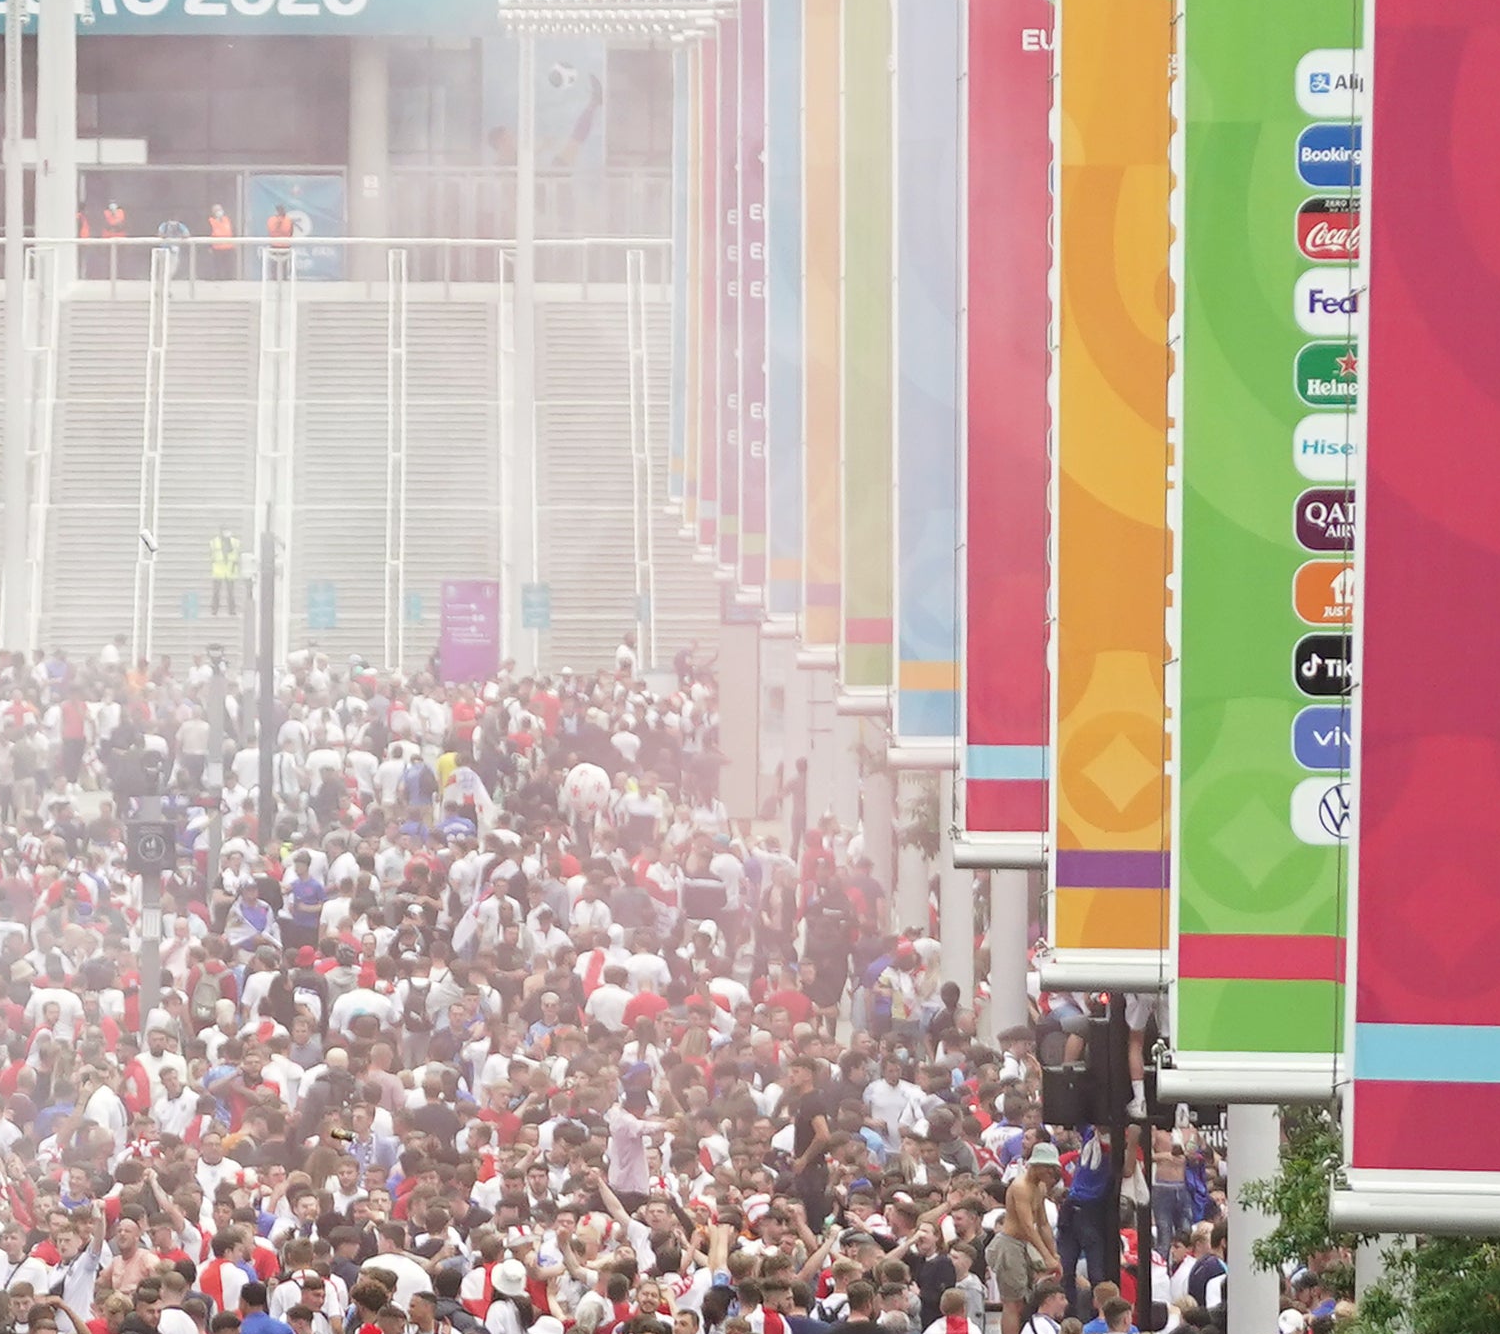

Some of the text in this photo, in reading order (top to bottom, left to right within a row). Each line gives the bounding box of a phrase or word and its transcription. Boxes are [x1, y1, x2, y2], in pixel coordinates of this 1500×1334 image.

[1301, 146, 1362, 165] Booking
[1308, 289, 1358, 314] Fed
[1306, 378, 1359, 396] Heine
[1302, 439, 1355, 455] Hise
